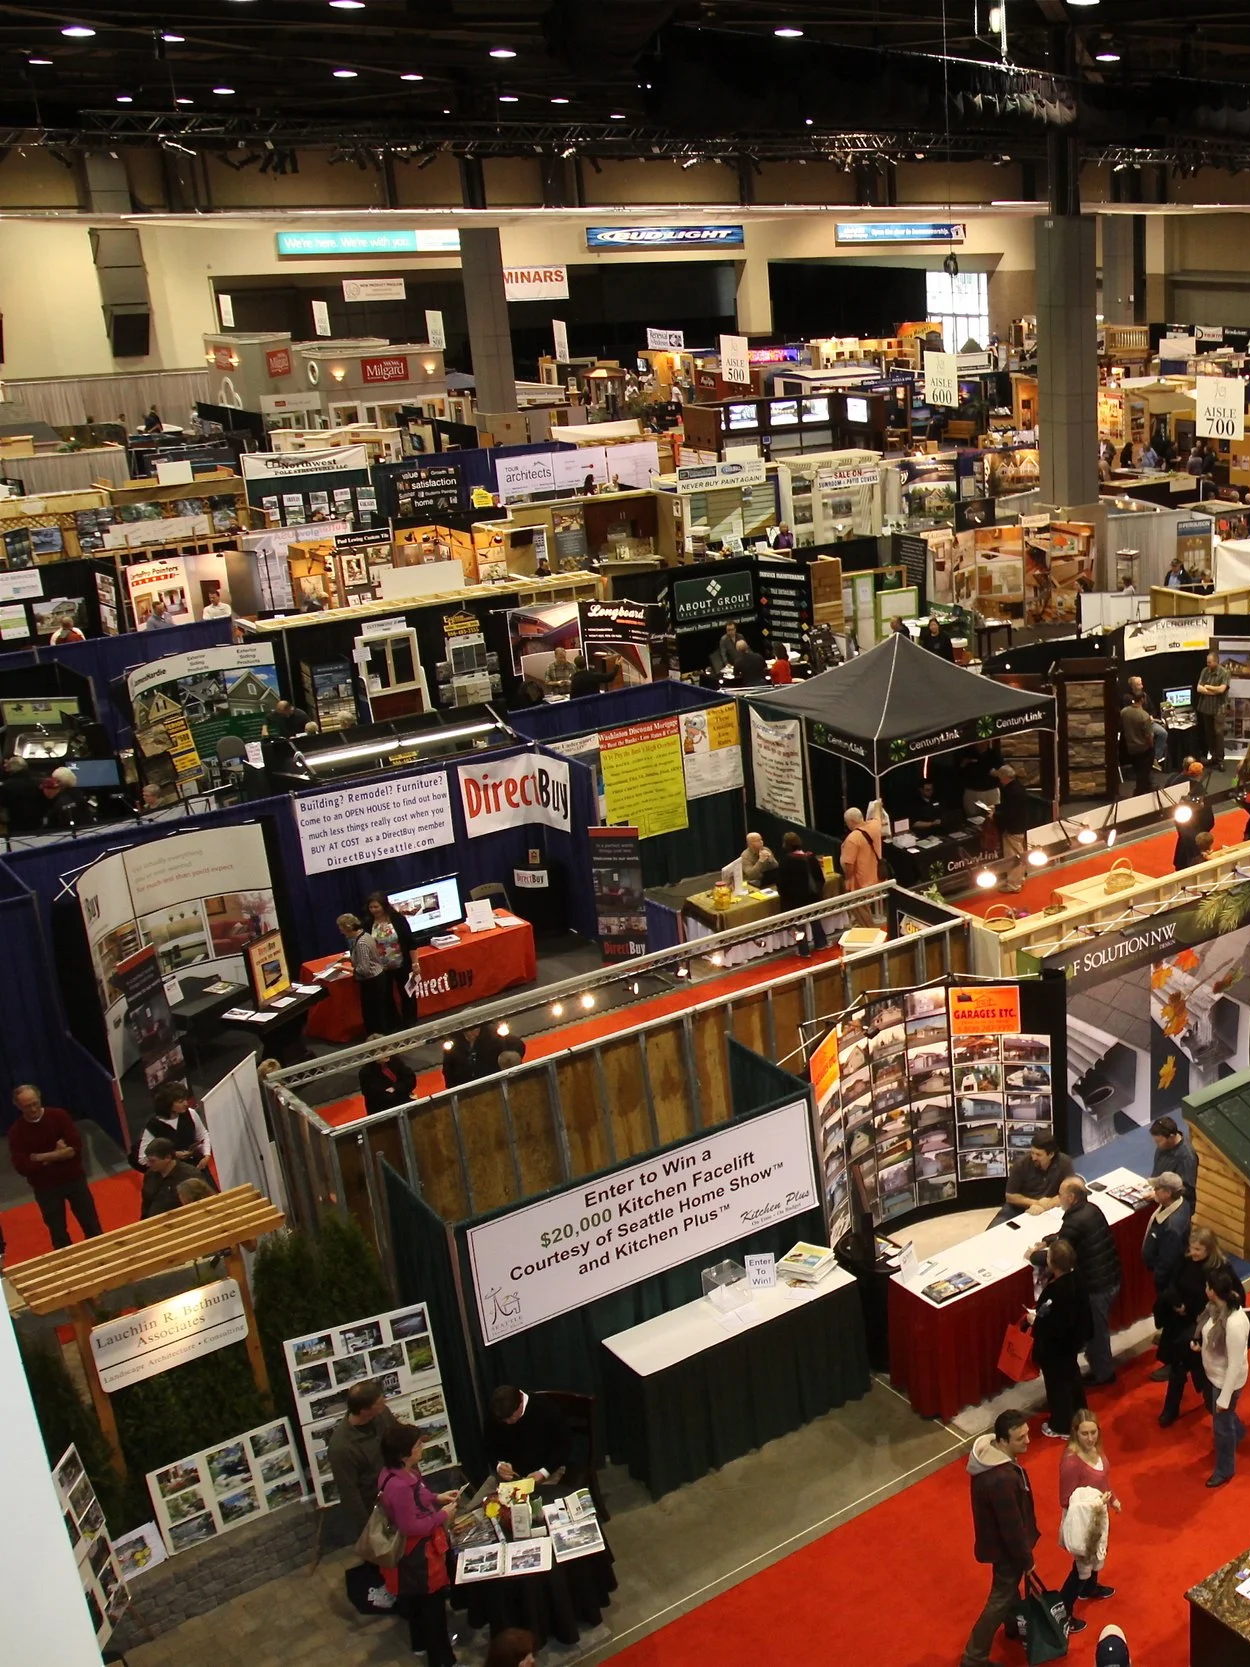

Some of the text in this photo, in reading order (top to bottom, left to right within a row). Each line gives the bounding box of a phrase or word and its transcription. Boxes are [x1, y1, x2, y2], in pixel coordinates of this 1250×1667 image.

[284, 237, 313, 249] We're
[316, 237, 338, 248] here.
[340, 237, 368, 248] We're
[370, 237, 390, 247] with
[616, 230, 732, 240] BUD LIGHT
[503, 270, 564, 284] MINARS
[366, 362, 404, 380] Milgard
[726, 358, 744, 367] AISLE
[728, 368, 745, 381] 500
[930, 377, 953, 388] AISLE
[932, 388, 952, 405] 600
[1204, 408, 1237, 419] AISLE
[1206, 418, 1235, 436] 700
[282, 458, 337, 469] Northwest
[293, 466, 335, 474] STRUCTURES
[506, 468, 552, 483] architects
[818, 480, 842, 488] SUNROOM
[846, 477, 860, 485] PATIO
[834, 469, 863, 479] SALE ON
[411, 478, 457, 490] satisfaction
[681, 480, 704, 490] NEVER
[152, 566, 179, 575] Painters
[678, 594, 751, 613] ABOUT GROUT
[702, 602, 751, 614] SPECIALTIES
[588, 604, 645, 621] Longboard
[1156, 618, 1208, 629] EVERGREEN
[628, 724, 653, 736] Discount
[654, 720, 678, 731] Mortgage
[996, 710, 1043, 729] CenturyLink
[828, 734, 865, 757] CenturyLink
[909, 729, 960, 751] CenturyLink
[300, 776, 443, 812] Building? Remodel? Furniture?
[464, 768, 569, 820] DirectBuy
[300, 818, 321, 827] Come
[345, 808, 364, 818] OPEN
[367, 804, 390, 814] HOUSE
[393, 801, 401, 809] to
[402, 797, 417, 806] find
[418, 796, 431, 804] out
[432, 792, 448, 801] how
[309, 808, 444, 841] much less things really cost when you
[311, 844, 326, 855] BUY
[329, 842, 338, 851] AT
[341, 838, 360, 849] COST
[382, 827, 416, 840] DirectBuy
[418, 820, 445, 833] member
[328, 837, 435, 867] DirectBuySeattle.com
[176, 870, 191, 880] than
[516, 872, 544, 884] DirectBuy
[604, 941, 646, 956] DirectBuy
[1084, 923, 1176, 972] SOLUTION NW
[416, 969, 473, 998] irectBuy
[954, 1008, 1017, 1019] GARAGES ETC.
[584, 1150, 712, 1209] Enter to Win a
[540, 1151, 755, 1249] $20,000 Kitchen Facelift
[740, 1190, 810, 1224] Kitchen Plus
[510, 1240, 590, 1281] Courtesy
[596, 1230, 613, 1247] of
[618, 1205, 675, 1238] Seattle
[678, 1188, 725, 1213] Home
[578, 1253, 611, 1276] and
[615, 1228, 679, 1261] Kitchen
[749, 1259, 771, 1267] Enter
[96, 1290, 237, 1349] Lauchlin R. Bethune
[136, 1316, 206, 1348] Associates
[104, 1325, 244, 1384] Landscape Architecture Consulting
